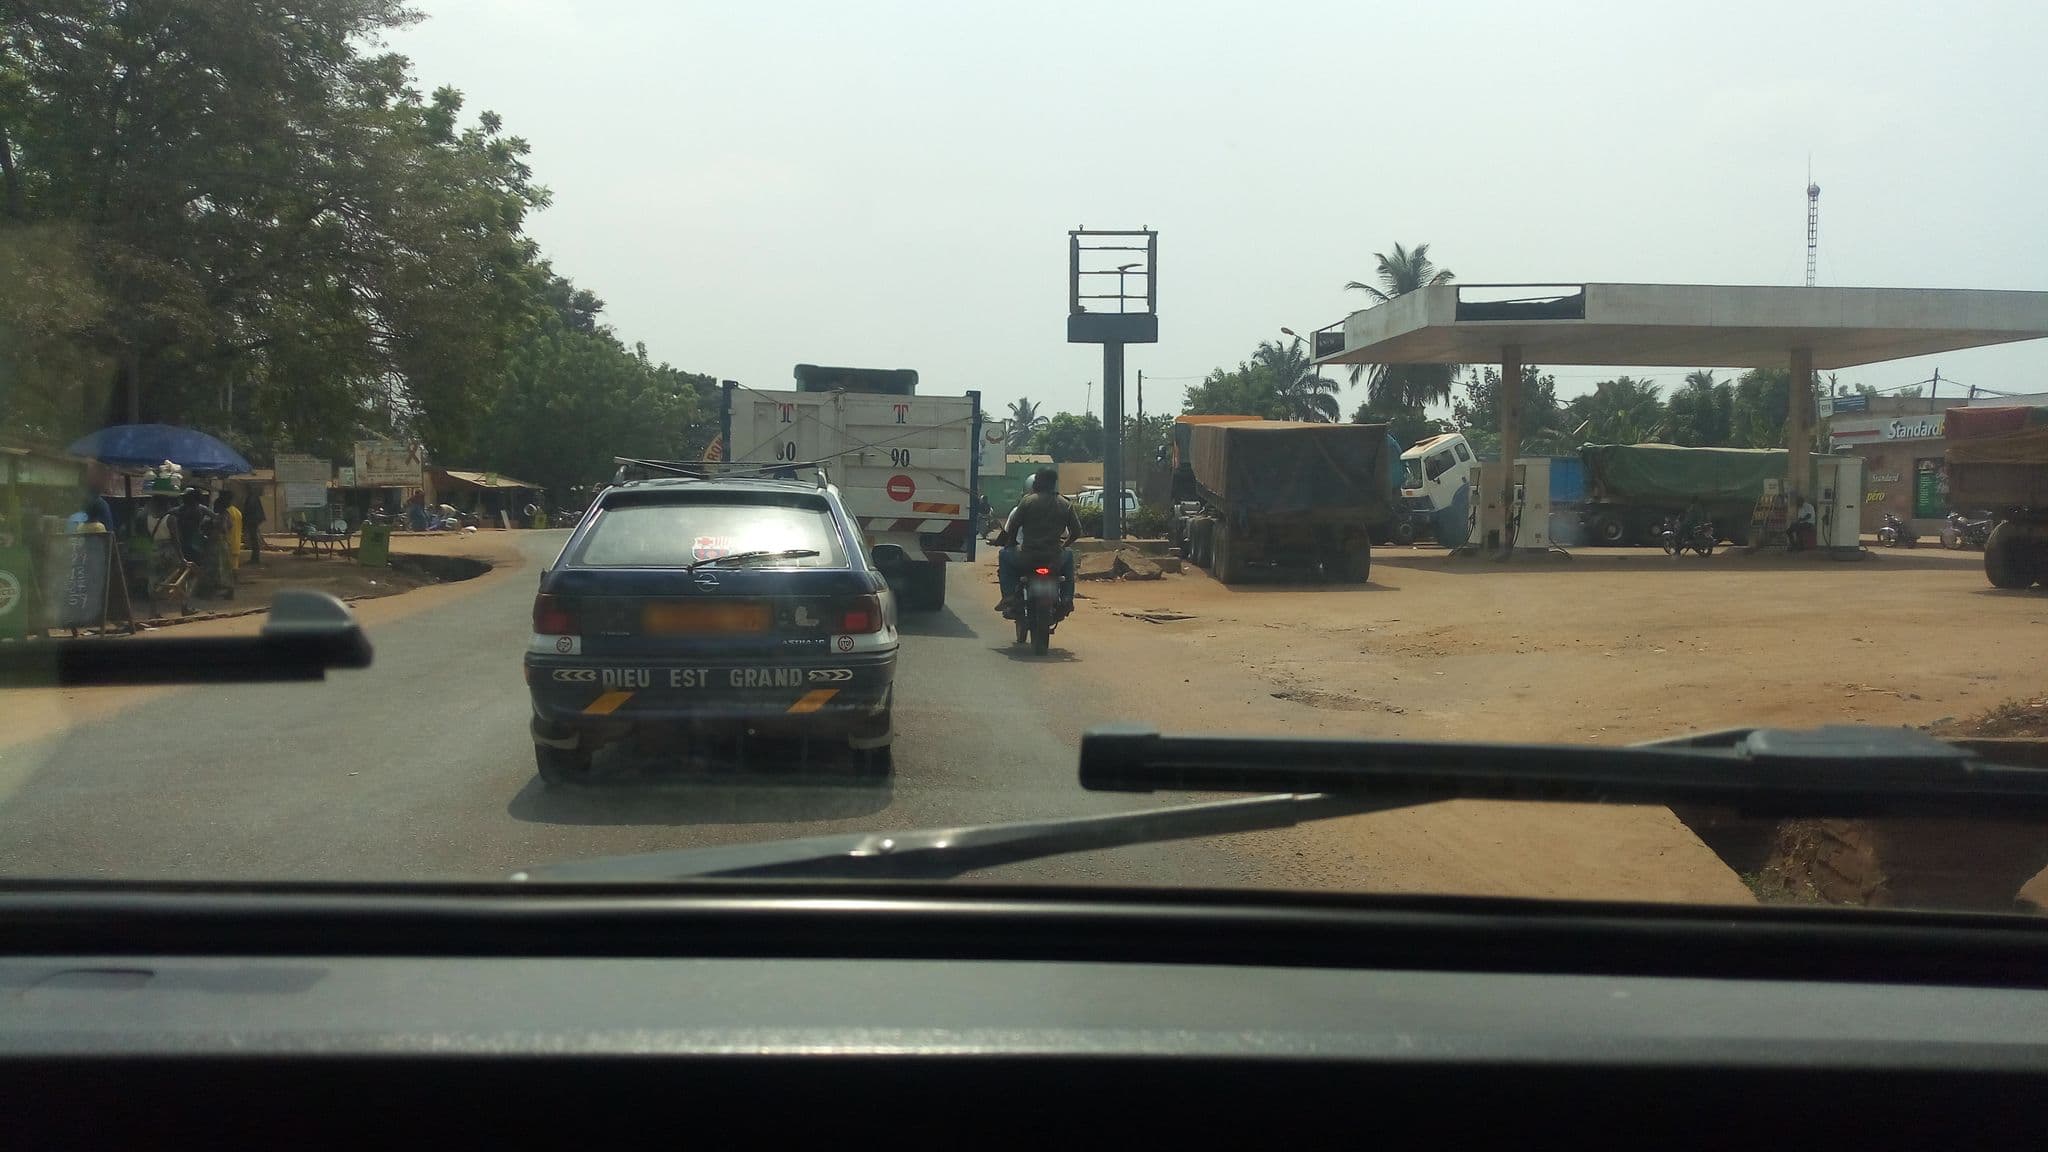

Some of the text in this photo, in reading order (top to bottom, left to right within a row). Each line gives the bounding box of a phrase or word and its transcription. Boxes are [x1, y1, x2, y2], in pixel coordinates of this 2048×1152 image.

[891, 448, 910, 467] 90
[602, 668, 803, 688] DIEU EST GRAND
